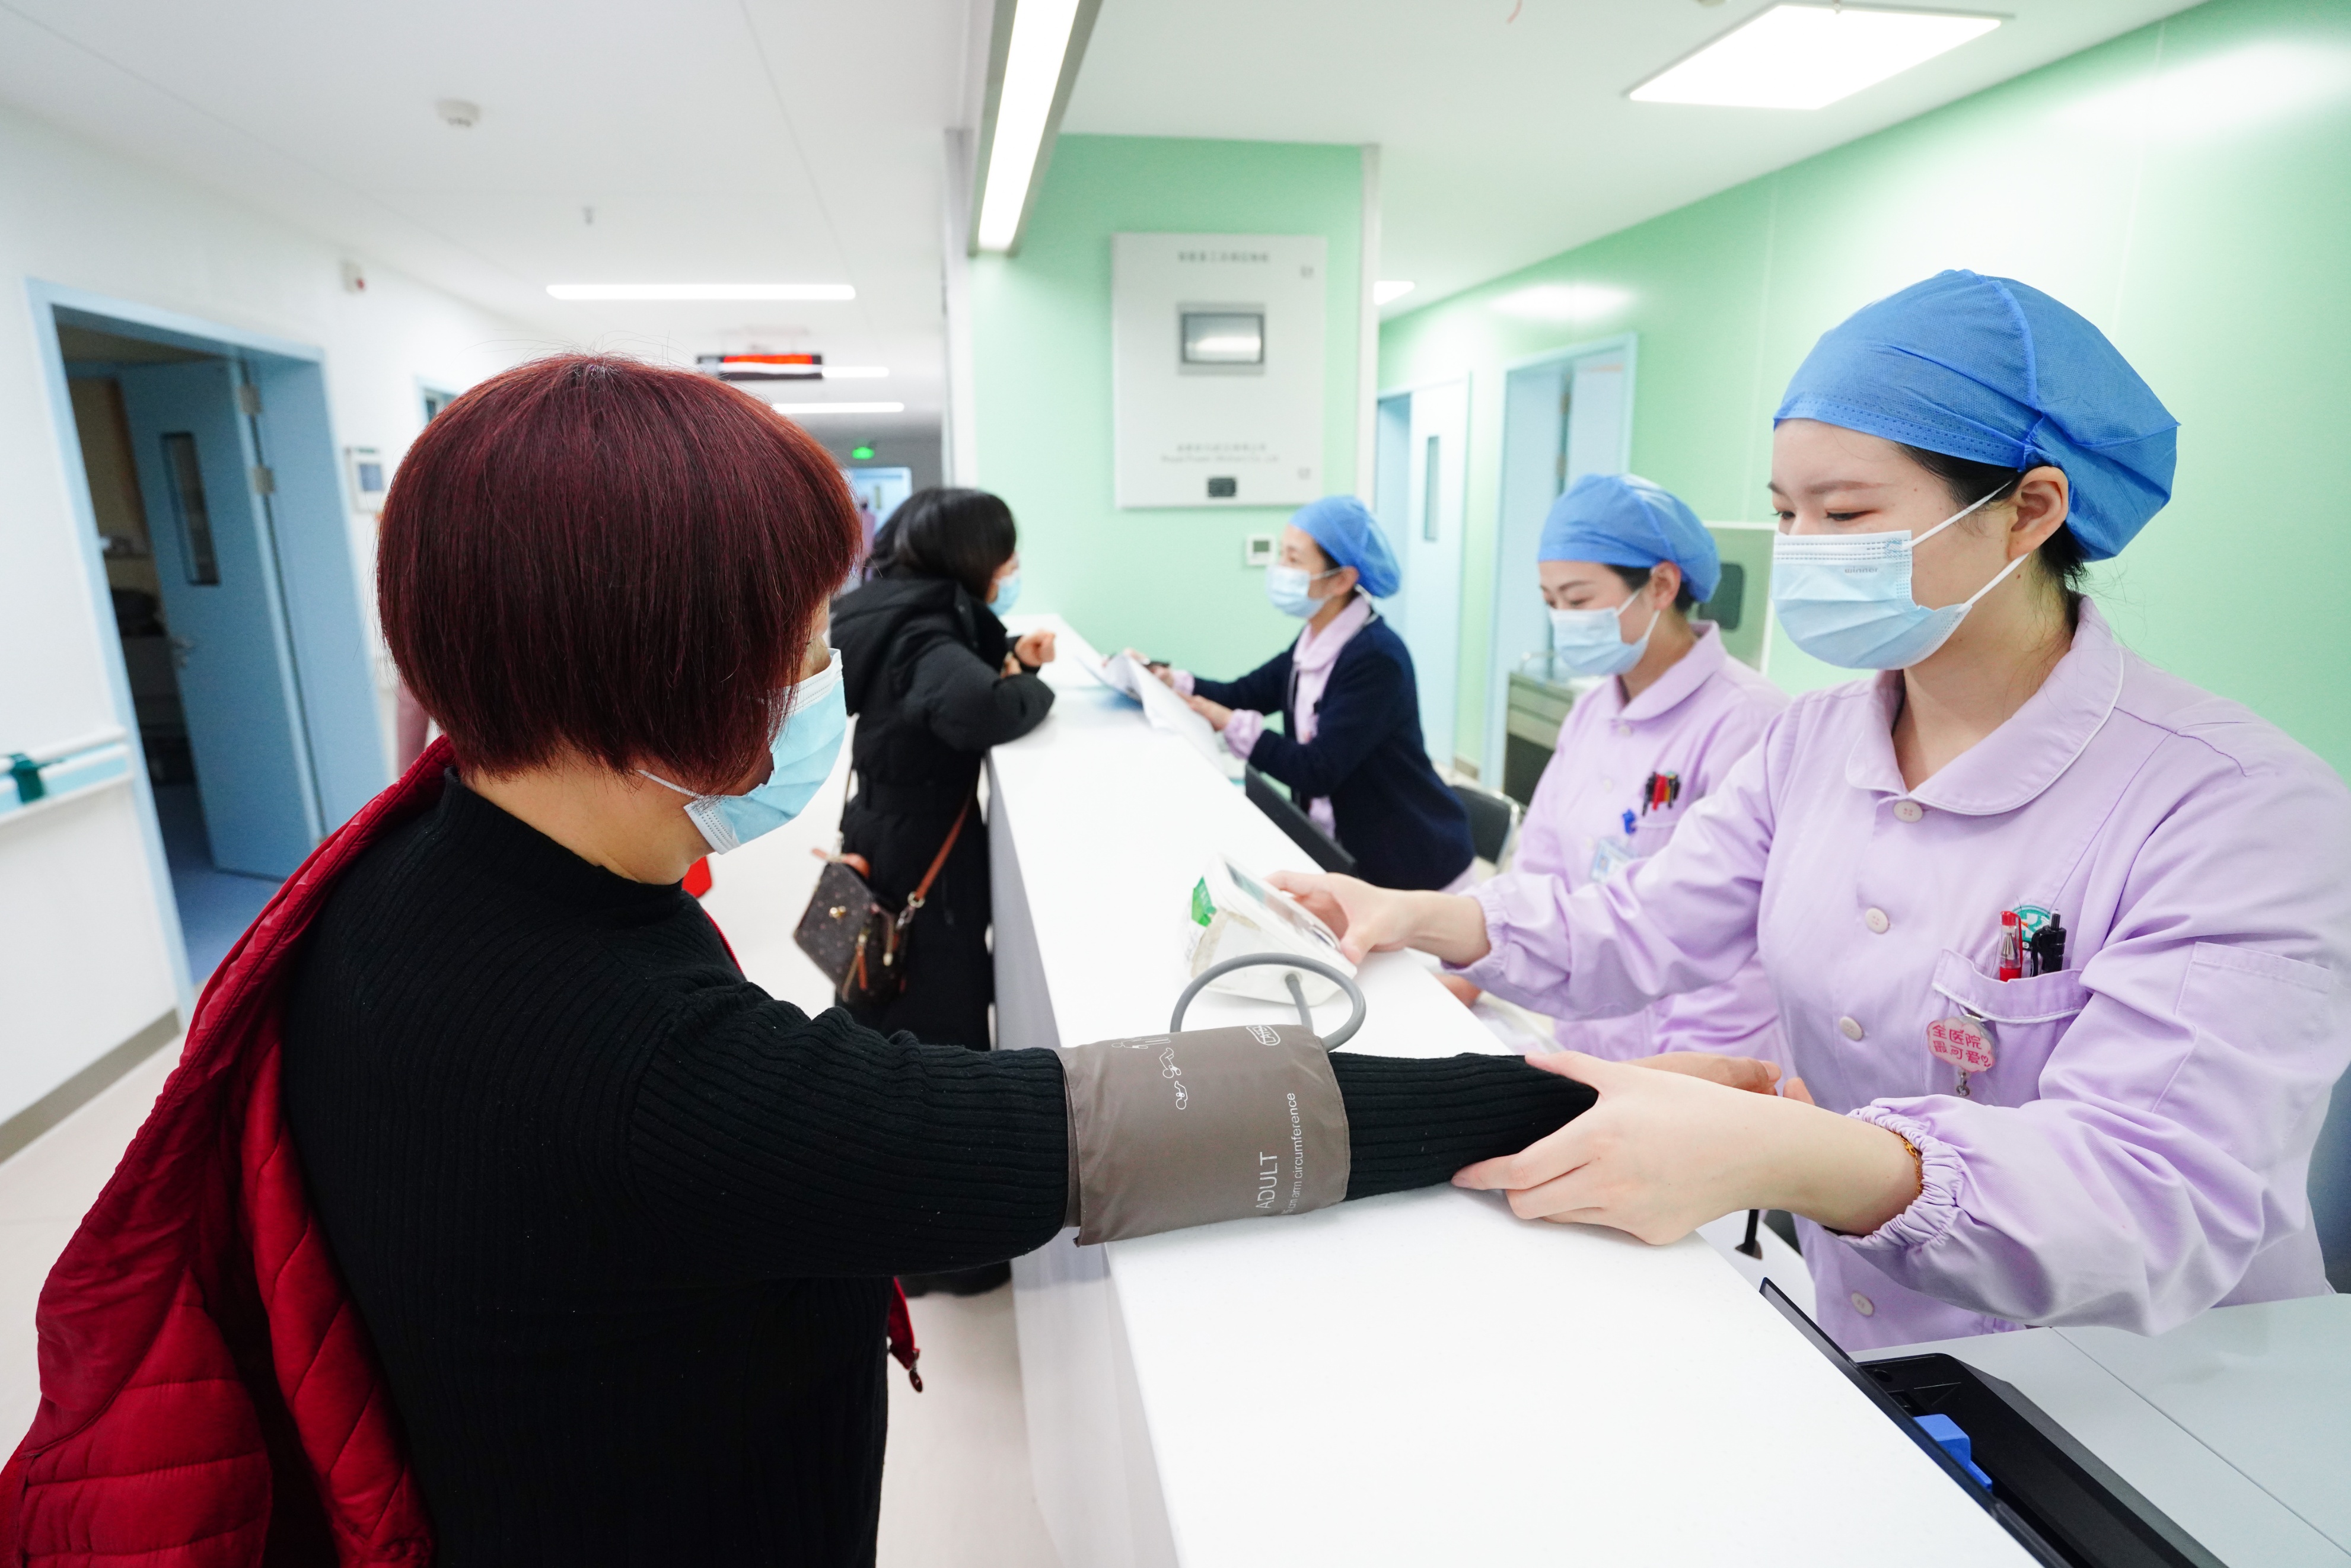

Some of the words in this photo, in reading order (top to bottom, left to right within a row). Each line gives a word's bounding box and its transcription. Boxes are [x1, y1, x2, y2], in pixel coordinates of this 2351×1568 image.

[1932, 1025, 1982, 1050] 全医院
[1287, 1093, 1303, 1178] circumference
[1256, 1152, 1277, 1208] ADULT
[1292, 1181, 1302, 1197] arm
